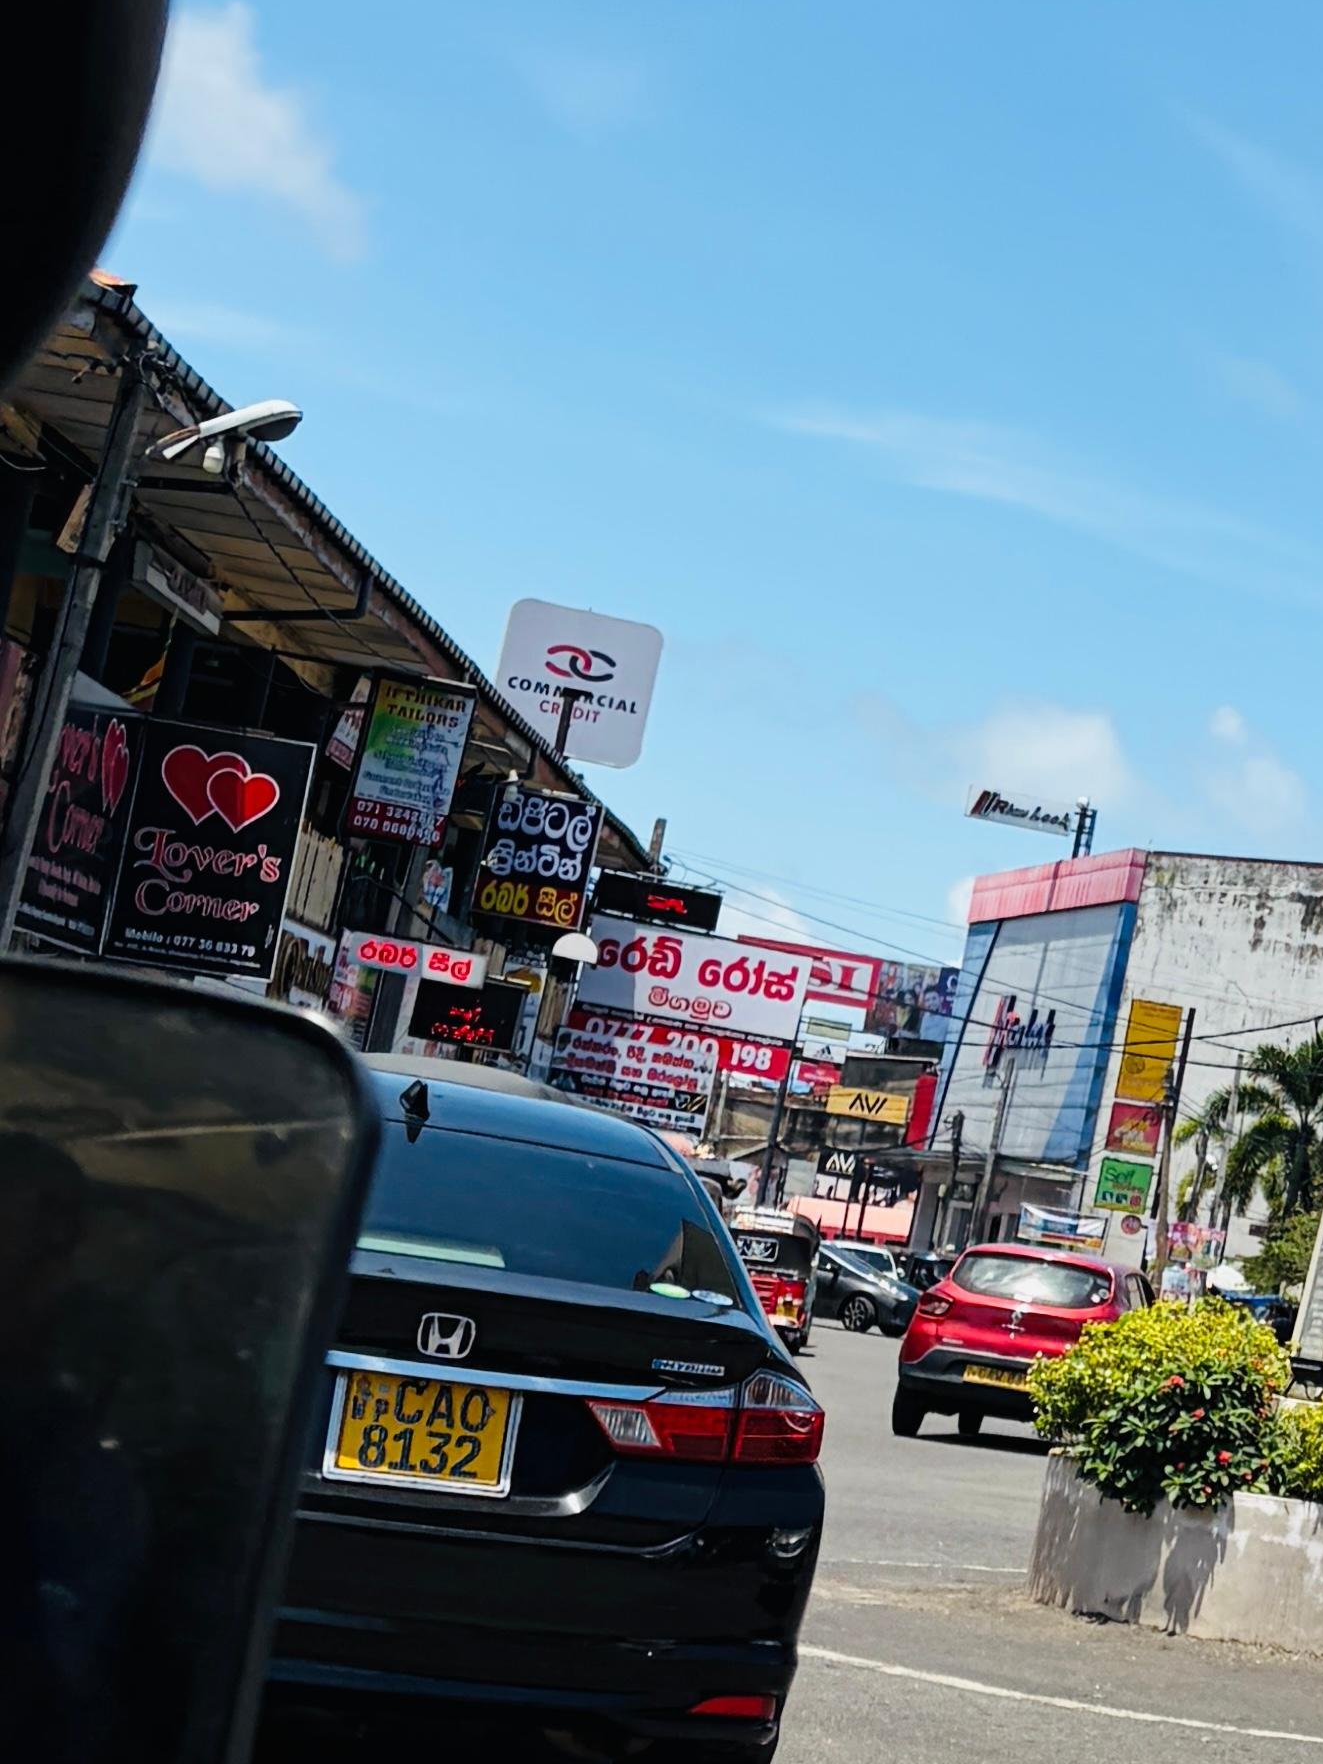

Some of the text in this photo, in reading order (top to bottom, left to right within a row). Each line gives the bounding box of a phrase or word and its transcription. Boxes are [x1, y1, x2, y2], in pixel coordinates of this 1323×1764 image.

[507, 675, 638, 716] COMRCIAL
[539, 700, 601, 724] CRDIT
[386, 703, 460, 728] TAILORS
[133, 826, 282, 883] Lover's
[135, 879, 260, 922] Corner
[811, 961, 858, 992] SI
[731, 1043, 774, 1071] 198
[358, 1424, 481, 1478] 8132
